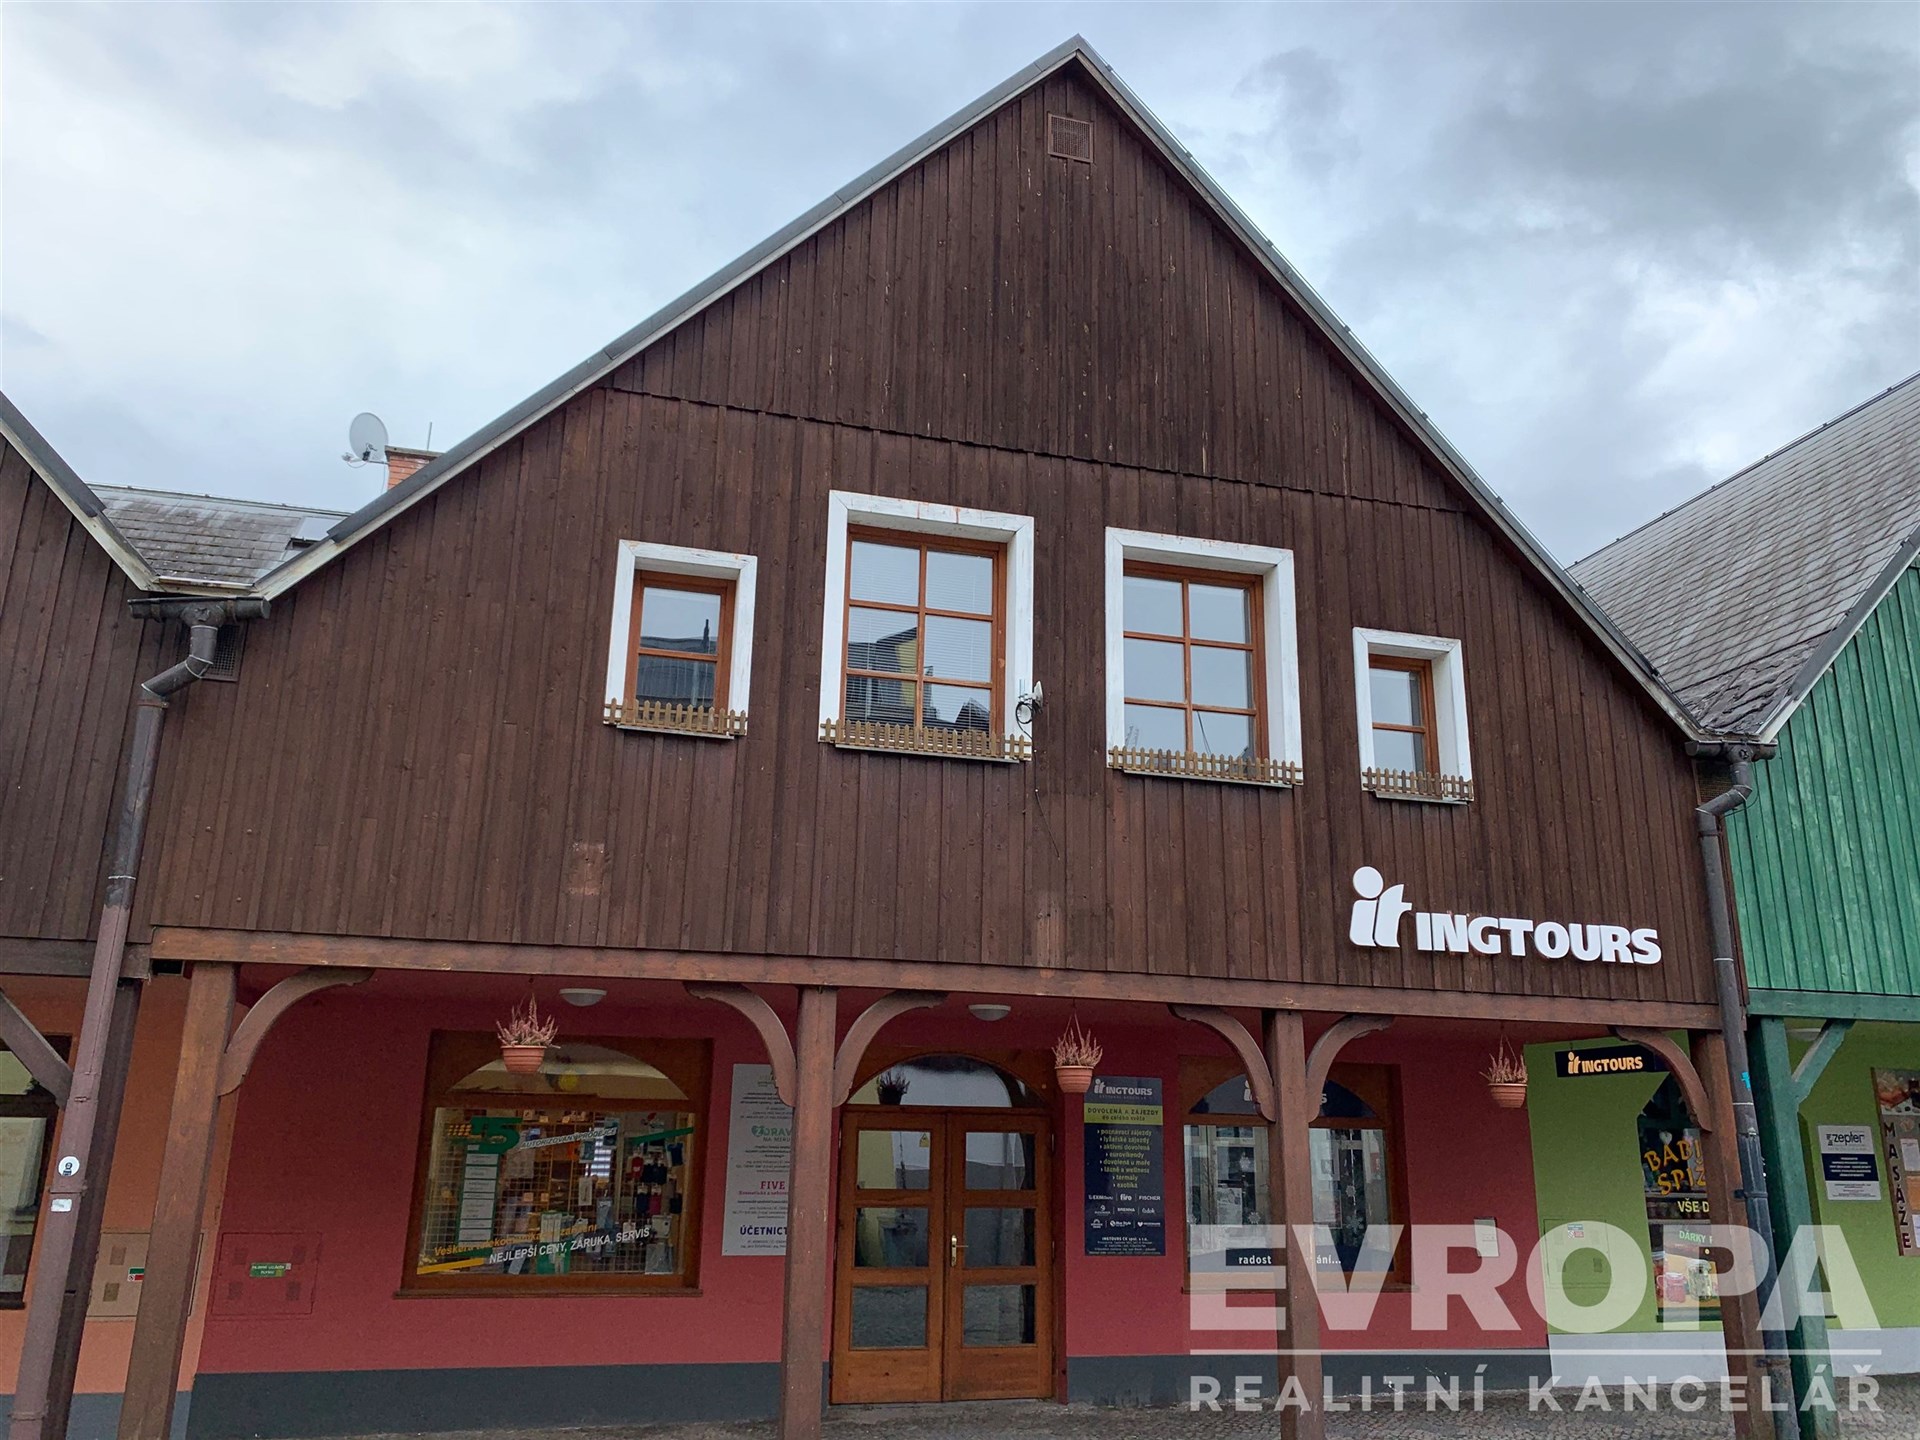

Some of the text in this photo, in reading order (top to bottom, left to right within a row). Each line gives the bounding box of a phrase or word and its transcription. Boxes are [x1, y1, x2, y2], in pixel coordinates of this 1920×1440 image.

[1416, 912, 1662, 964] INGTOURS
[1582, 1056, 1643, 1073] INGTOURS
[1106, 1086, 1153, 1096] INGTOURS
[1087, 1107, 1123, 1115] DOVOLENÁ
[760, 1181, 786, 1190] FIVE
[1677, 1198, 1700, 1213] VŠE
[489, 1247, 537, 1264] NEJLEPŠÍ
[615, 1227, 650, 1243] SERVIS
[1238, 1255, 1272, 1265] radost
